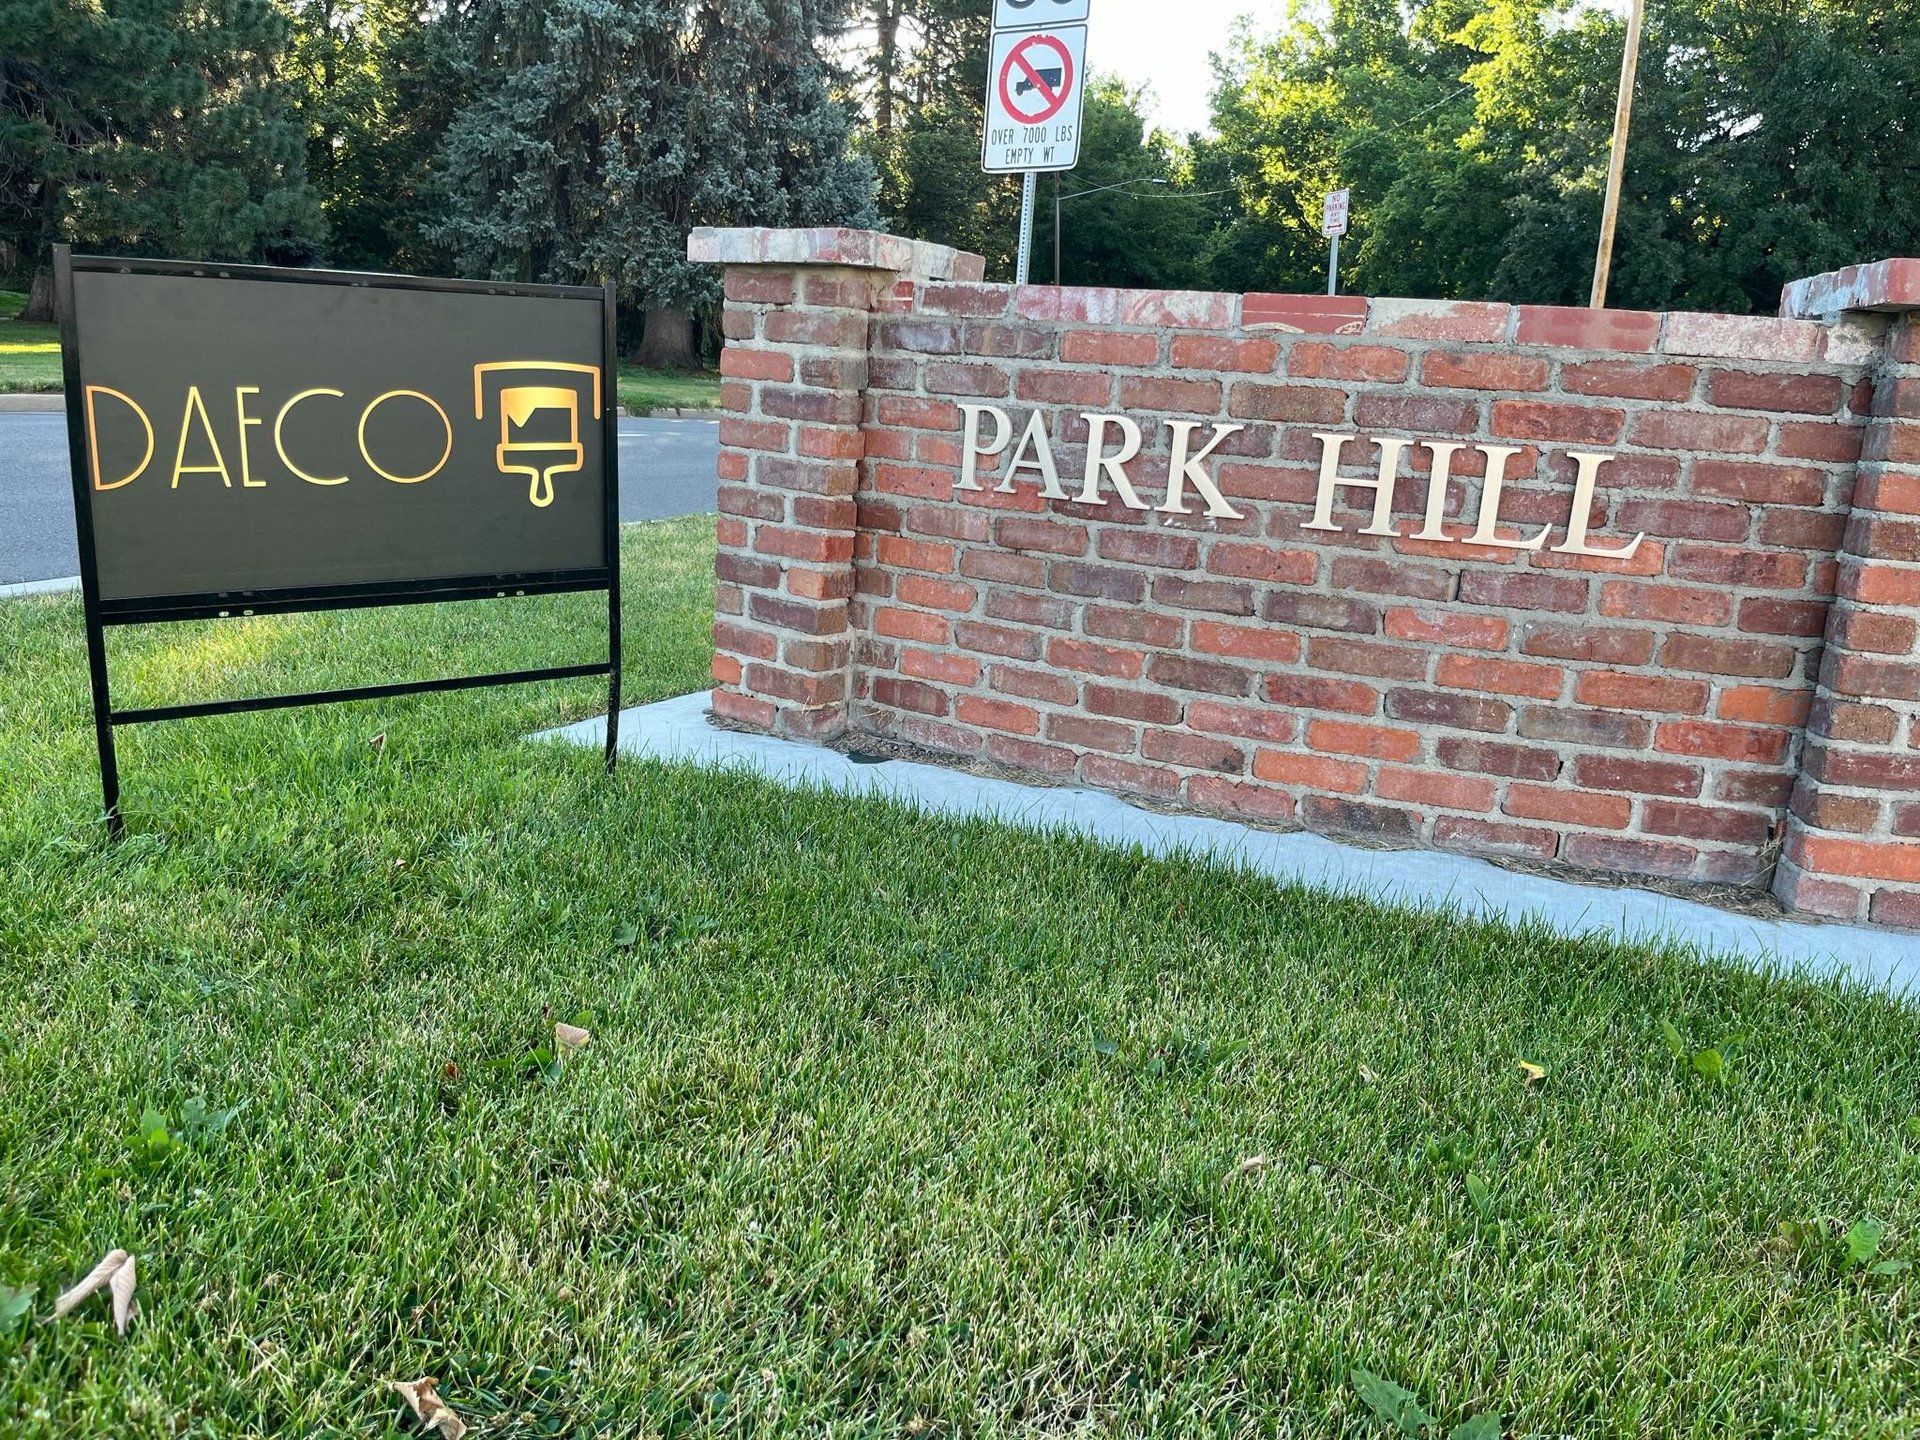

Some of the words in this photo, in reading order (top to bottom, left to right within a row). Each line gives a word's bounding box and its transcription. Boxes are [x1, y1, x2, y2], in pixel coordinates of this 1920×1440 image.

[991, 128, 1014, 145] OVER
[1023, 126, 1047, 144] 7000
[1055, 125, 1073, 142] LBS
[1005, 147, 1034, 165] EMPTY
[1043, 146, 1055, 163] WT
[1325, 202, 1346, 211] PARKING
[1332, 194, 1341, 202] NO
[85, 385, 453, 490] DAECO
[952, 403, 1246, 521] PARK
[1299, 432, 1645, 560] HILL
